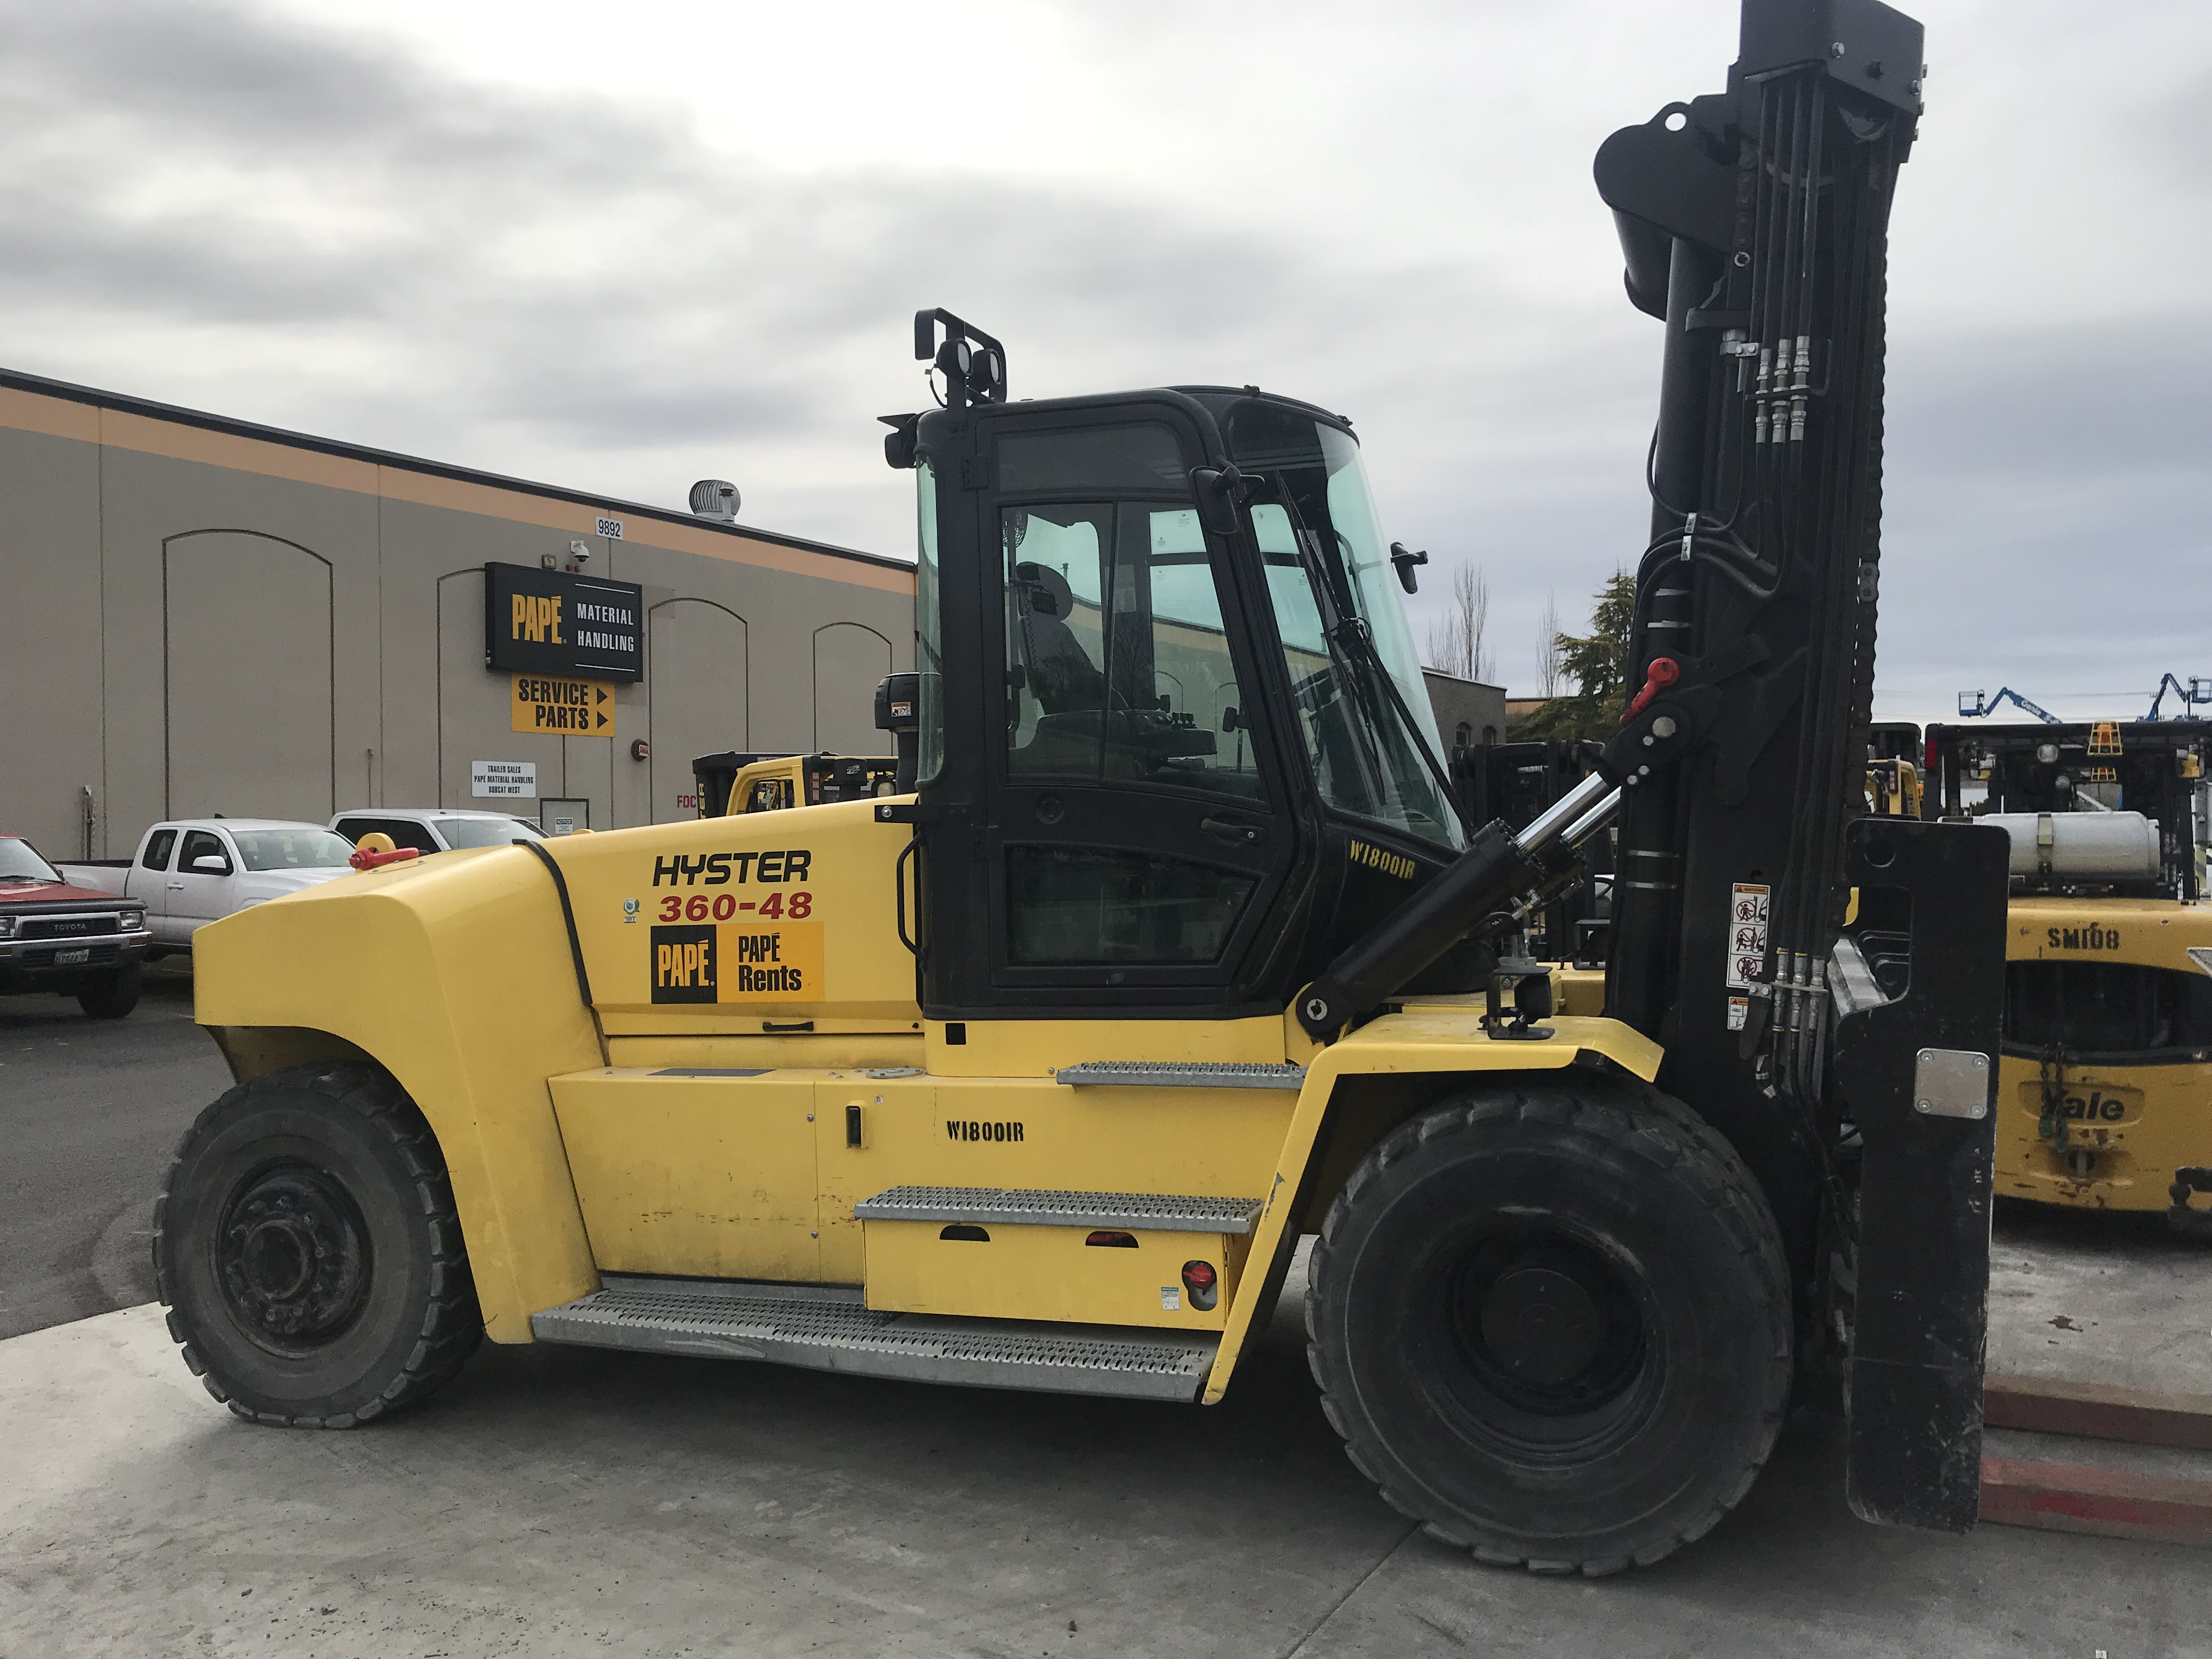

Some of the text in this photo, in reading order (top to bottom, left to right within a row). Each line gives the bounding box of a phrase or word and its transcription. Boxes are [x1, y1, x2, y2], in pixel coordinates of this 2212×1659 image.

[599, 519, 620, 537] 9892
[577, 603, 634, 625] MATERIAL
[577, 630, 635, 652] HANDLING
[518, 679, 588, 706] SERVICE
[535, 705, 589, 730] PARTS
[487, 775, 510, 783] MATERIAL
[677, 795, 696, 808] FDC
[653, 850, 811, 887] HYSTER
[658, 892, 812, 922] 360-48
[739, 965, 802, 992] Rents
